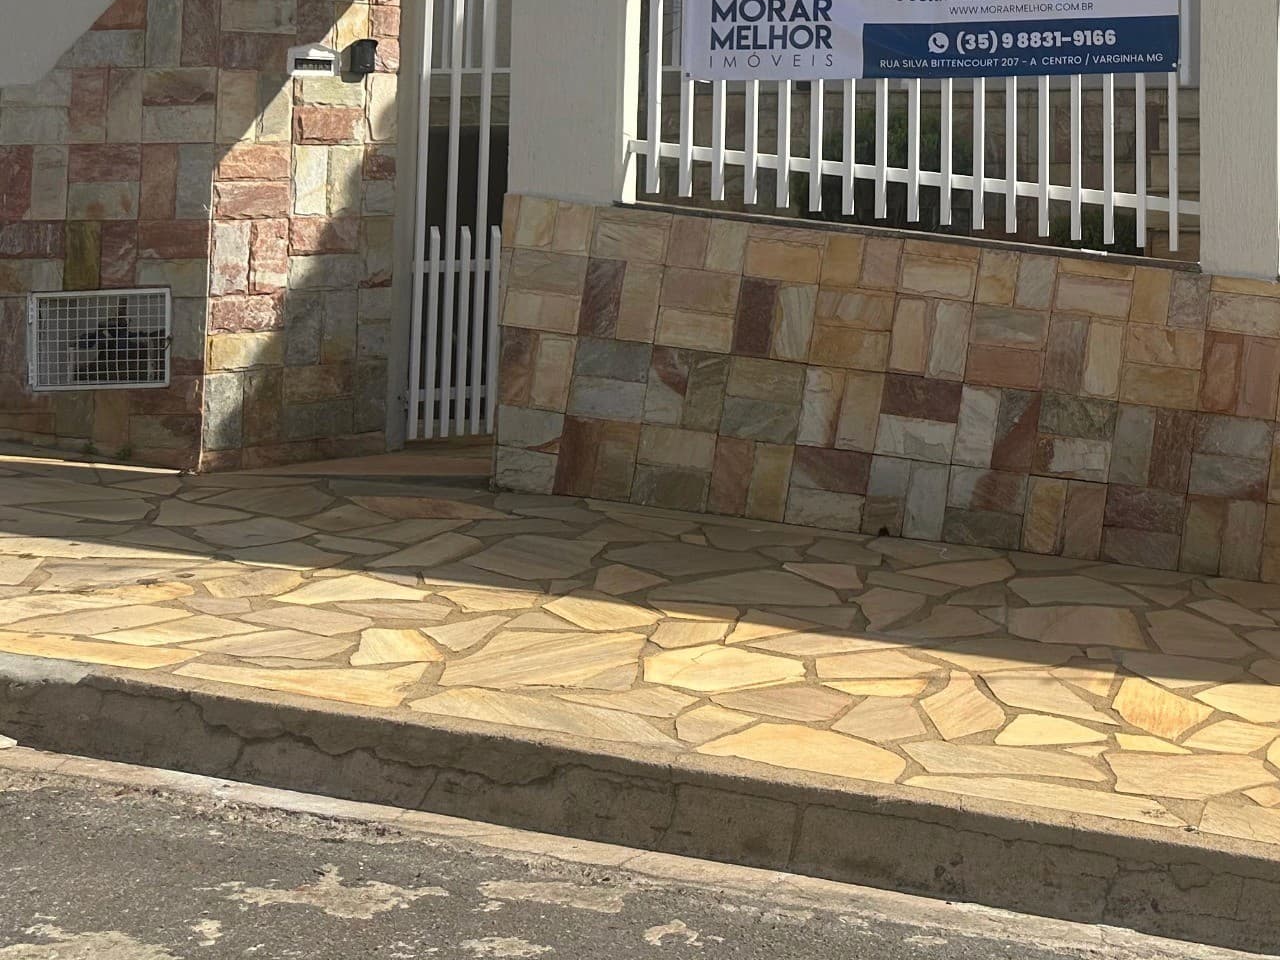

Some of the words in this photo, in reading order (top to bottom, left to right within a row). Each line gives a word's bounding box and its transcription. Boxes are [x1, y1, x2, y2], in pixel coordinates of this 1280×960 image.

[710, 25, 833, 50] MELHOR
[956, 30, 998, 54] (35)
[1001, 33, 1013, 48] 9
[1017, 29, 1117, 49] 8831-9166
[709, 51, 833, 68] IMÓVEIS
[880, 59, 900, 68] RUA
[902, 58, 928, 68] SILVA
[931, 58, 999, 68] BITTENCOURT
[1001, 57, 1019, 67] 207
[1030, 58, 1037, 66] A
[1041, 55, 1082, 66] CENTRO
[1092, 54, 1145, 64] VARGINHA
[1146, 52, 1164, 63] MG
